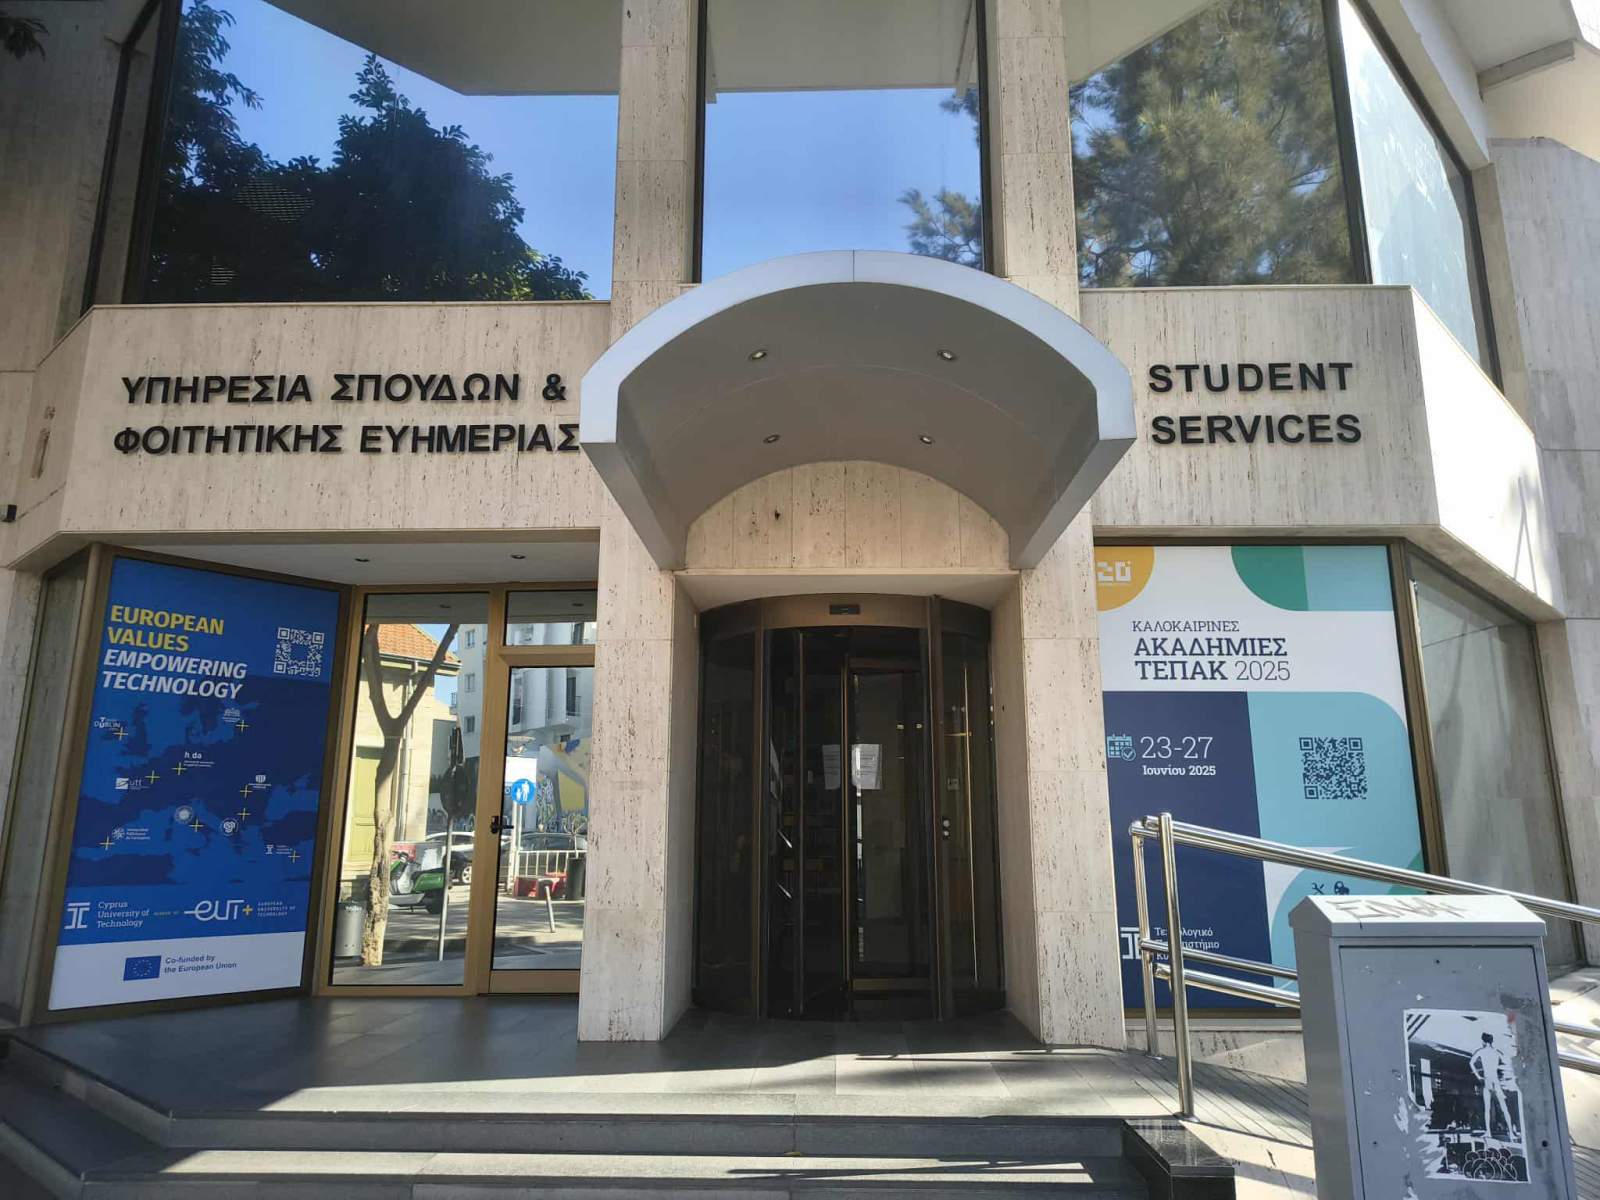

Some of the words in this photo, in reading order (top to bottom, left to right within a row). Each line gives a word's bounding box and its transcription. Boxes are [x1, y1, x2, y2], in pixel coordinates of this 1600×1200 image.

[121, 374, 313, 404] ΥΠΗΡΕΣΙΑ
[330, 373, 520, 402] ΣΠΟΥΔΩΝ
[542, 373, 568, 402] &
[1149, 363, 1353, 393] STUDENT
[113, 424, 344, 455] ΦΟΙΤΗΤΙΚΗΣ
[359, 423, 580, 454] ΕΥΗΜΕΡΙΑΣ
[1151, 414, 1362, 445] SERVICES
[110, 605, 225, 635] EUROPEAN
[1132, 620, 1240, 633] ΚΑΛΟΚΑΙΡΙΝΕΣ
[107, 627, 190, 652] VALUES
[1134, 637, 1288, 657] ΑΚΑΔΗΜΙΕΣ
[103, 649, 248, 679] EMPOWERING
[1135, 660, 1229, 681] ΤΕΠΑΚ
[1235, 660, 1291, 682] 2025
[102, 671, 243, 700] TECHNOLOGY
[1140, 736, 1214, 760] 23-27
[1142, 764, 1187, 777] Ιουνίου
[1189, 764, 1217, 777] 2025
[97, 909, 140, 919] University
[141, 909, 150, 917] of
[98, 901, 129, 909] Cyprus
[97, 919, 144, 929] Technology
[164, 966, 177, 974] the
[178, 963, 214, 973] European
[215, 961, 237, 970] Union
[165, 955, 205, 964] Co-funded
[206, 953, 216, 962] by
